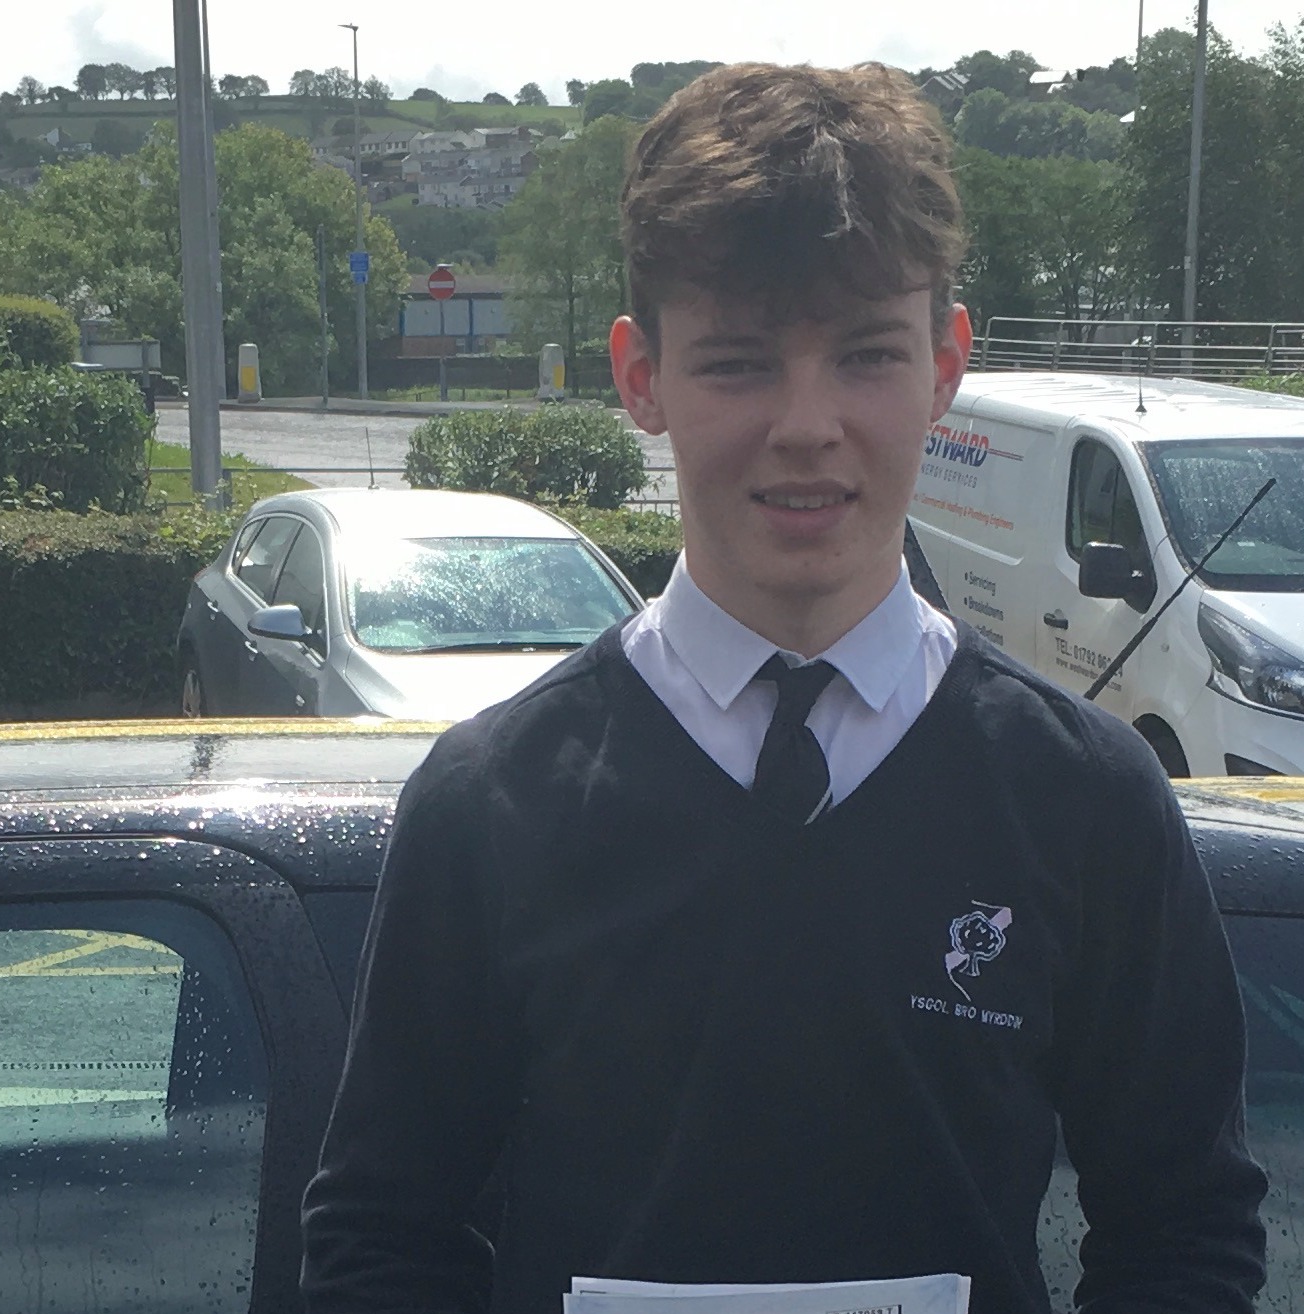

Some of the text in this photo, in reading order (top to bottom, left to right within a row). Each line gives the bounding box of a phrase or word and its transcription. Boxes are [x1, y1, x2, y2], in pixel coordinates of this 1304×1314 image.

[925, 424, 990, 468] STWARD
[921, 463, 942, 479] NERGY
[910, 994, 949, 1015] YSGOL
[954, 1003, 977, 1019] BRO
